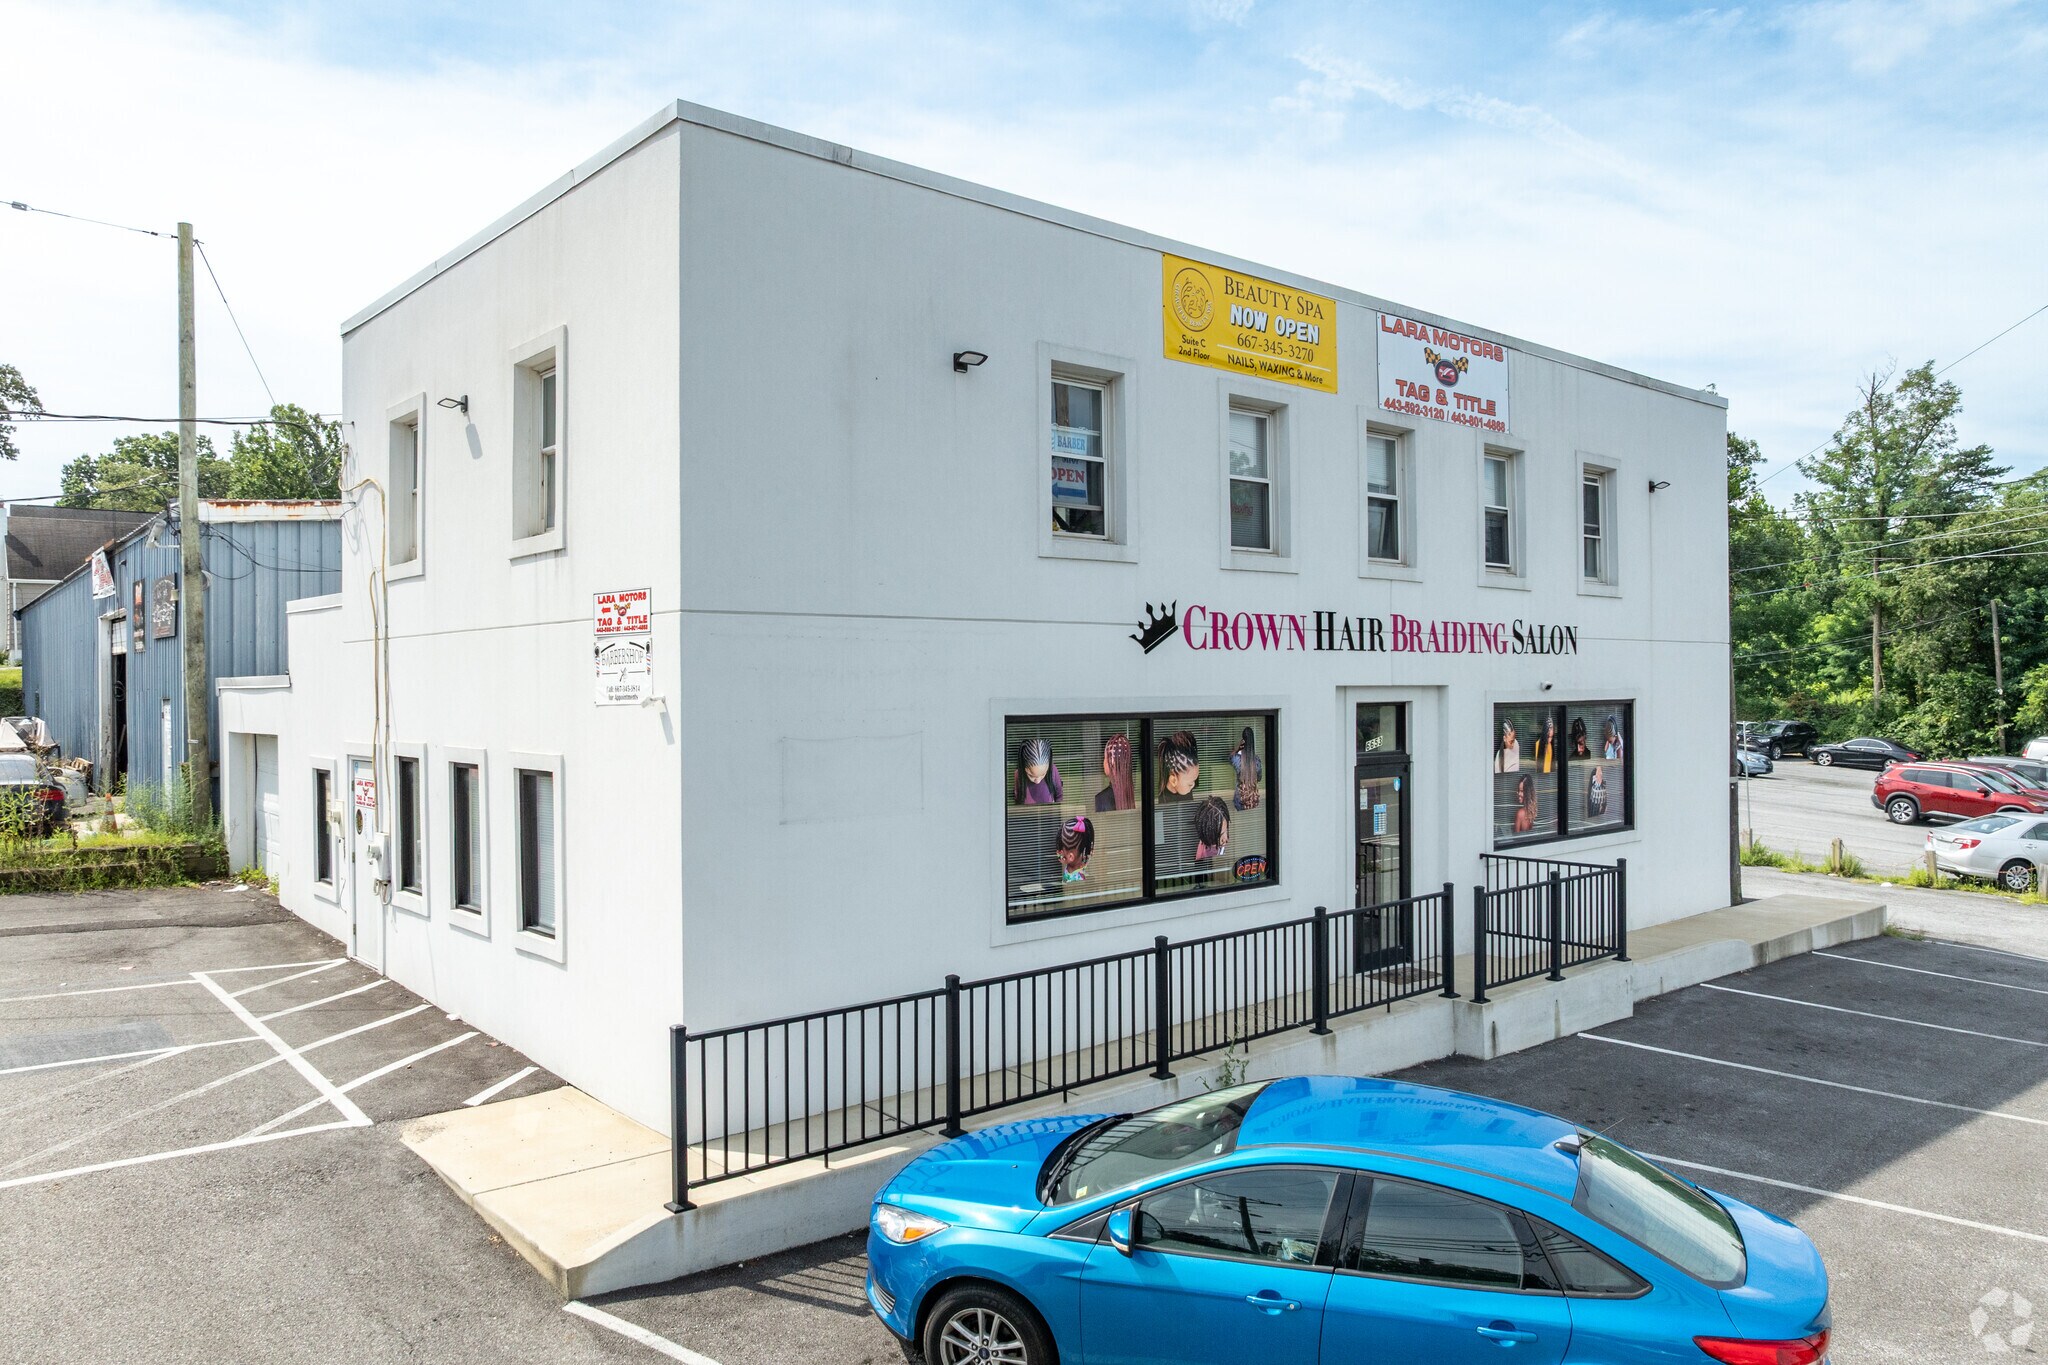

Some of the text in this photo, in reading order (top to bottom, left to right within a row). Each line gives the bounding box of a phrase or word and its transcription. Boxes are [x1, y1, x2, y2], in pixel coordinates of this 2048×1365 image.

[1224, 275, 1325, 320] BEAUTY SPA
[1230, 304, 1320, 345] NOW OPEN
[1381, 315, 1504, 361] LARA MOTORS
[1178, 346, 1210, 360] 2nd Floor
[1181, 334, 1206, 348] Suite C
[1237, 332, 1314, 363] 667-345-3270
[1227, 354, 1323, 384] NAILS, WAXING & More
[1395, 379, 1497, 417] TAG & TITLE
[1057, 435, 1086, 451] BARBER
[597, 591, 647, 605] LARA MOTORS
[597, 614, 648, 627] TAG & TITLE
[1182, 604, 1578, 656] CROWN HAIR BRAIDING SALON
[1236, 861, 1267, 877] OPEN
